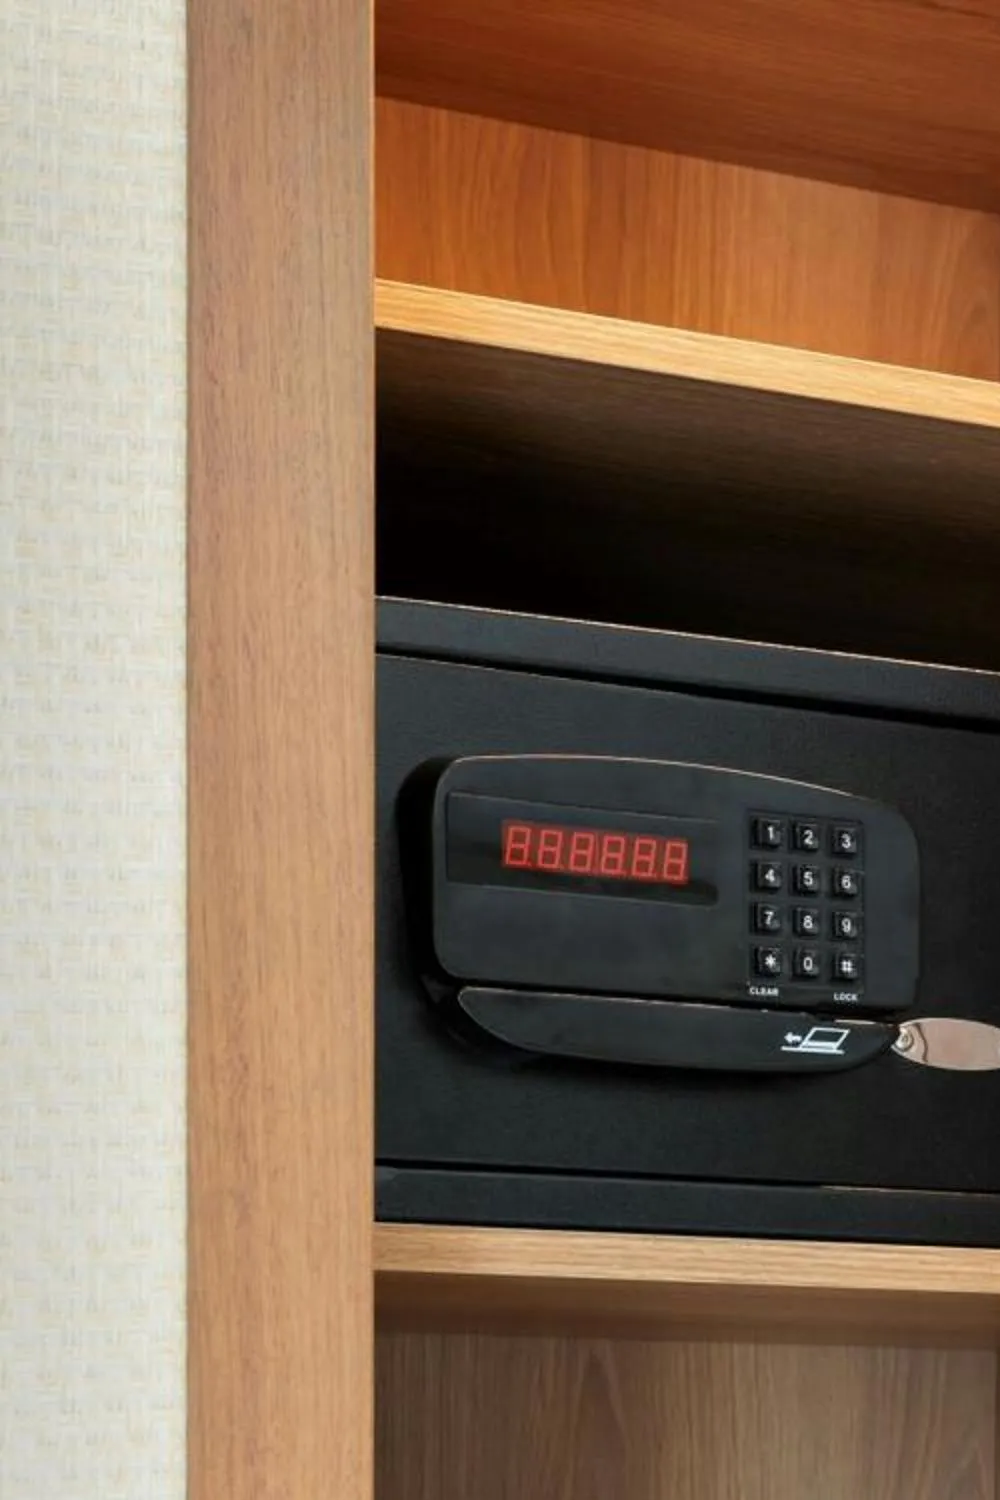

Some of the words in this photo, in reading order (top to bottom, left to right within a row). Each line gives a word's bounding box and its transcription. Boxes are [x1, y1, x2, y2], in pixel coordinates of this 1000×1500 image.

[767, 826, 774, 840] 1
[803, 829, 813, 845] 2
[841, 833, 851, 849] 3
[765, 868, 775, 882] 4
[803, 871, 813, 886] 5
[841, 875, 851, 889] 6
[765, 911, 774, 925] 7
[803, 915, 813, 929] 8
[842, 918, 851, 933] 9
[803, 956, 813, 971] 0
[750, 987, 779, 997] CLEAR
[834, 992, 859, 1001] LOCK
